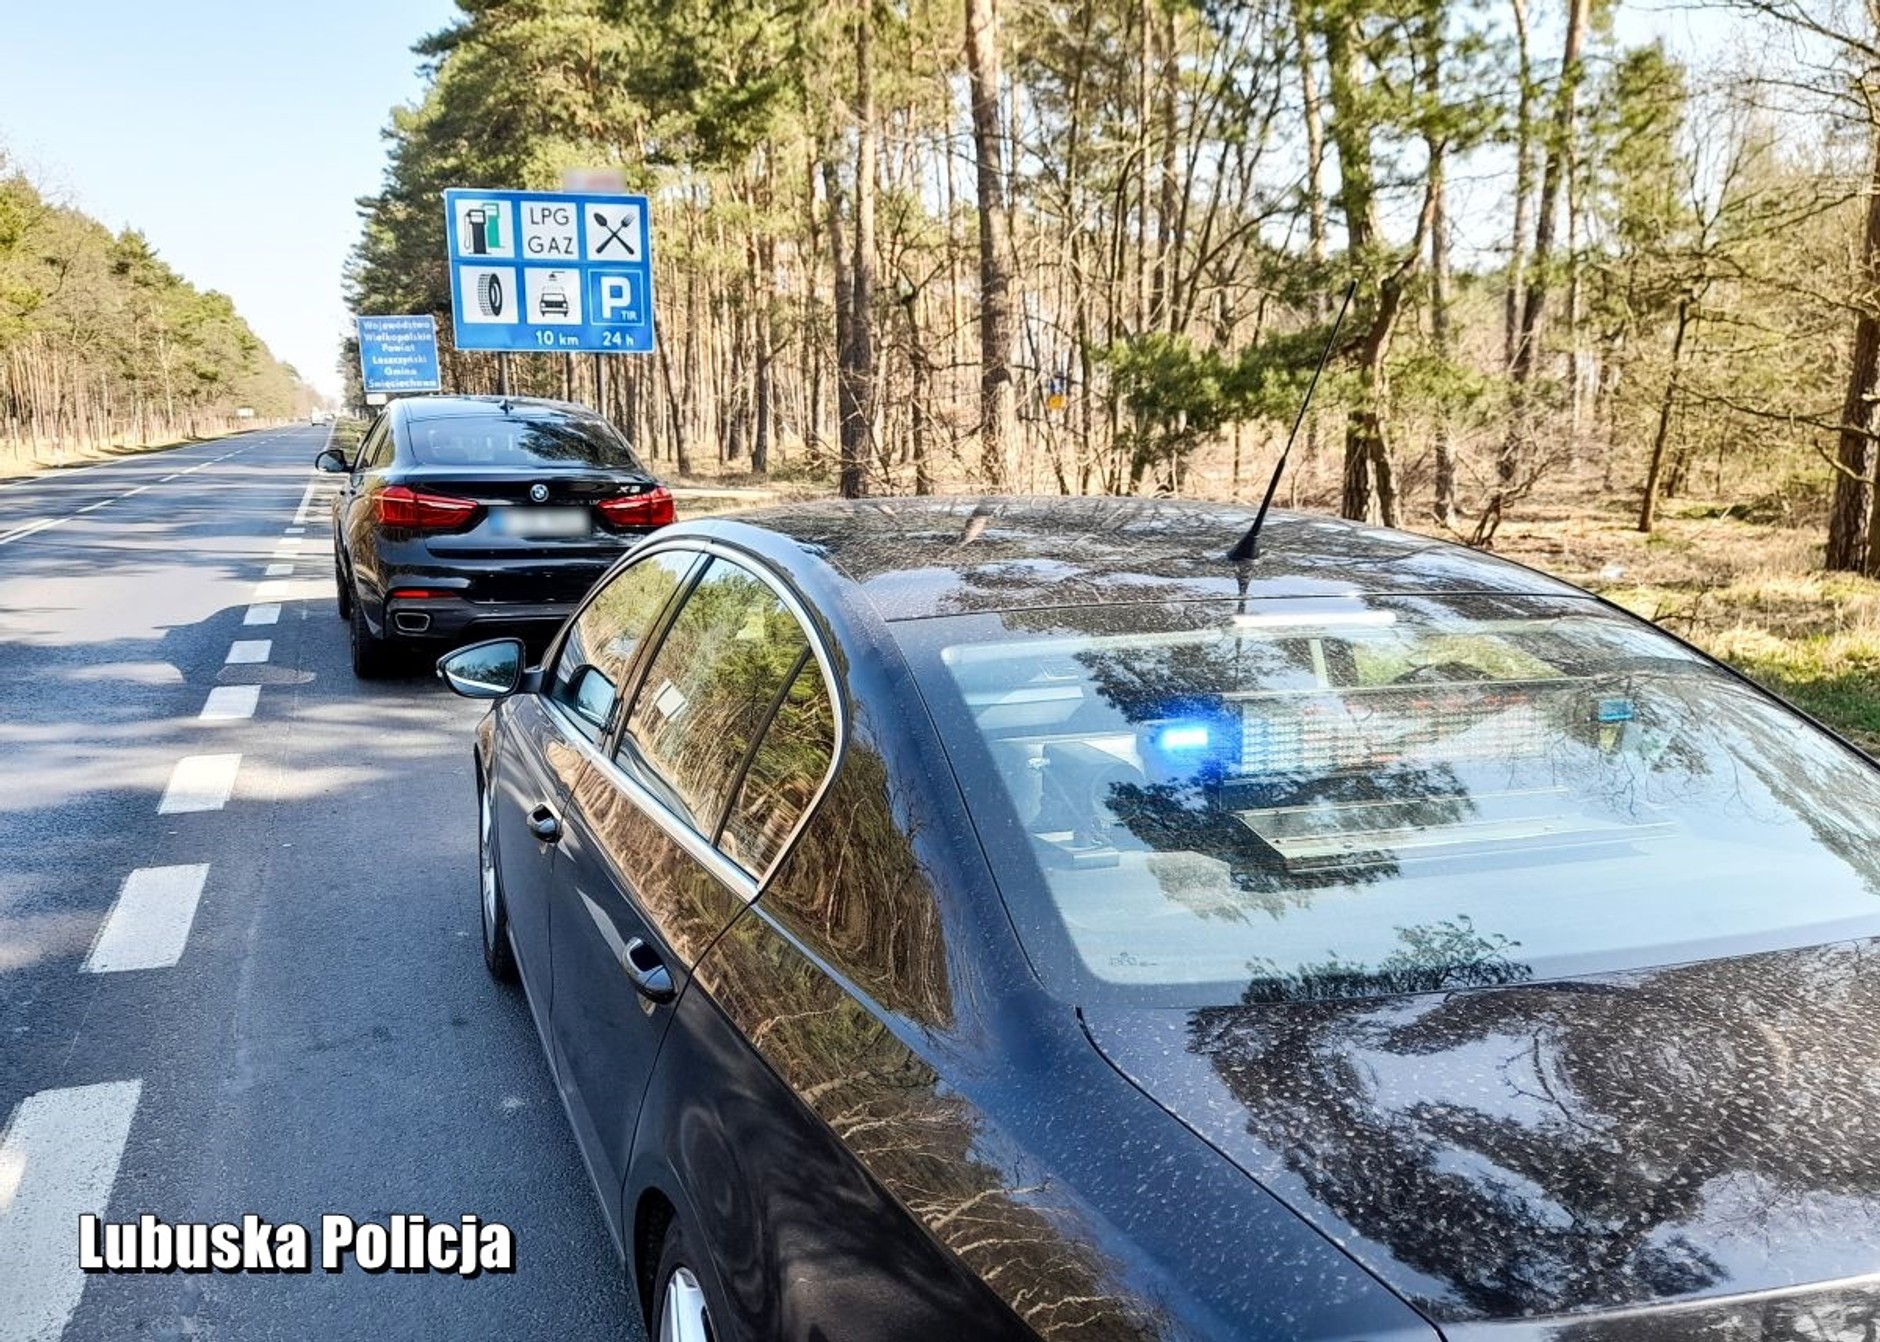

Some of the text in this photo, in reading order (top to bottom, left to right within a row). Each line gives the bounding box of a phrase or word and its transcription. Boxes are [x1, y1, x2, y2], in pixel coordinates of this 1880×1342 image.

[529, 206, 570, 226] LPG
[528, 236, 574, 255] GAZ
[600, 275, 632, 320] P
[620, 310, 638, 321] TIR
[363, 332, 432, 343] Wielkopolskie
[535, 330, 580, 346] 10 km
[602, 331, 635, 346] 24 h
[381, 343, 416, 352] Powiat
[383, 366, 417, 376] Gmina
